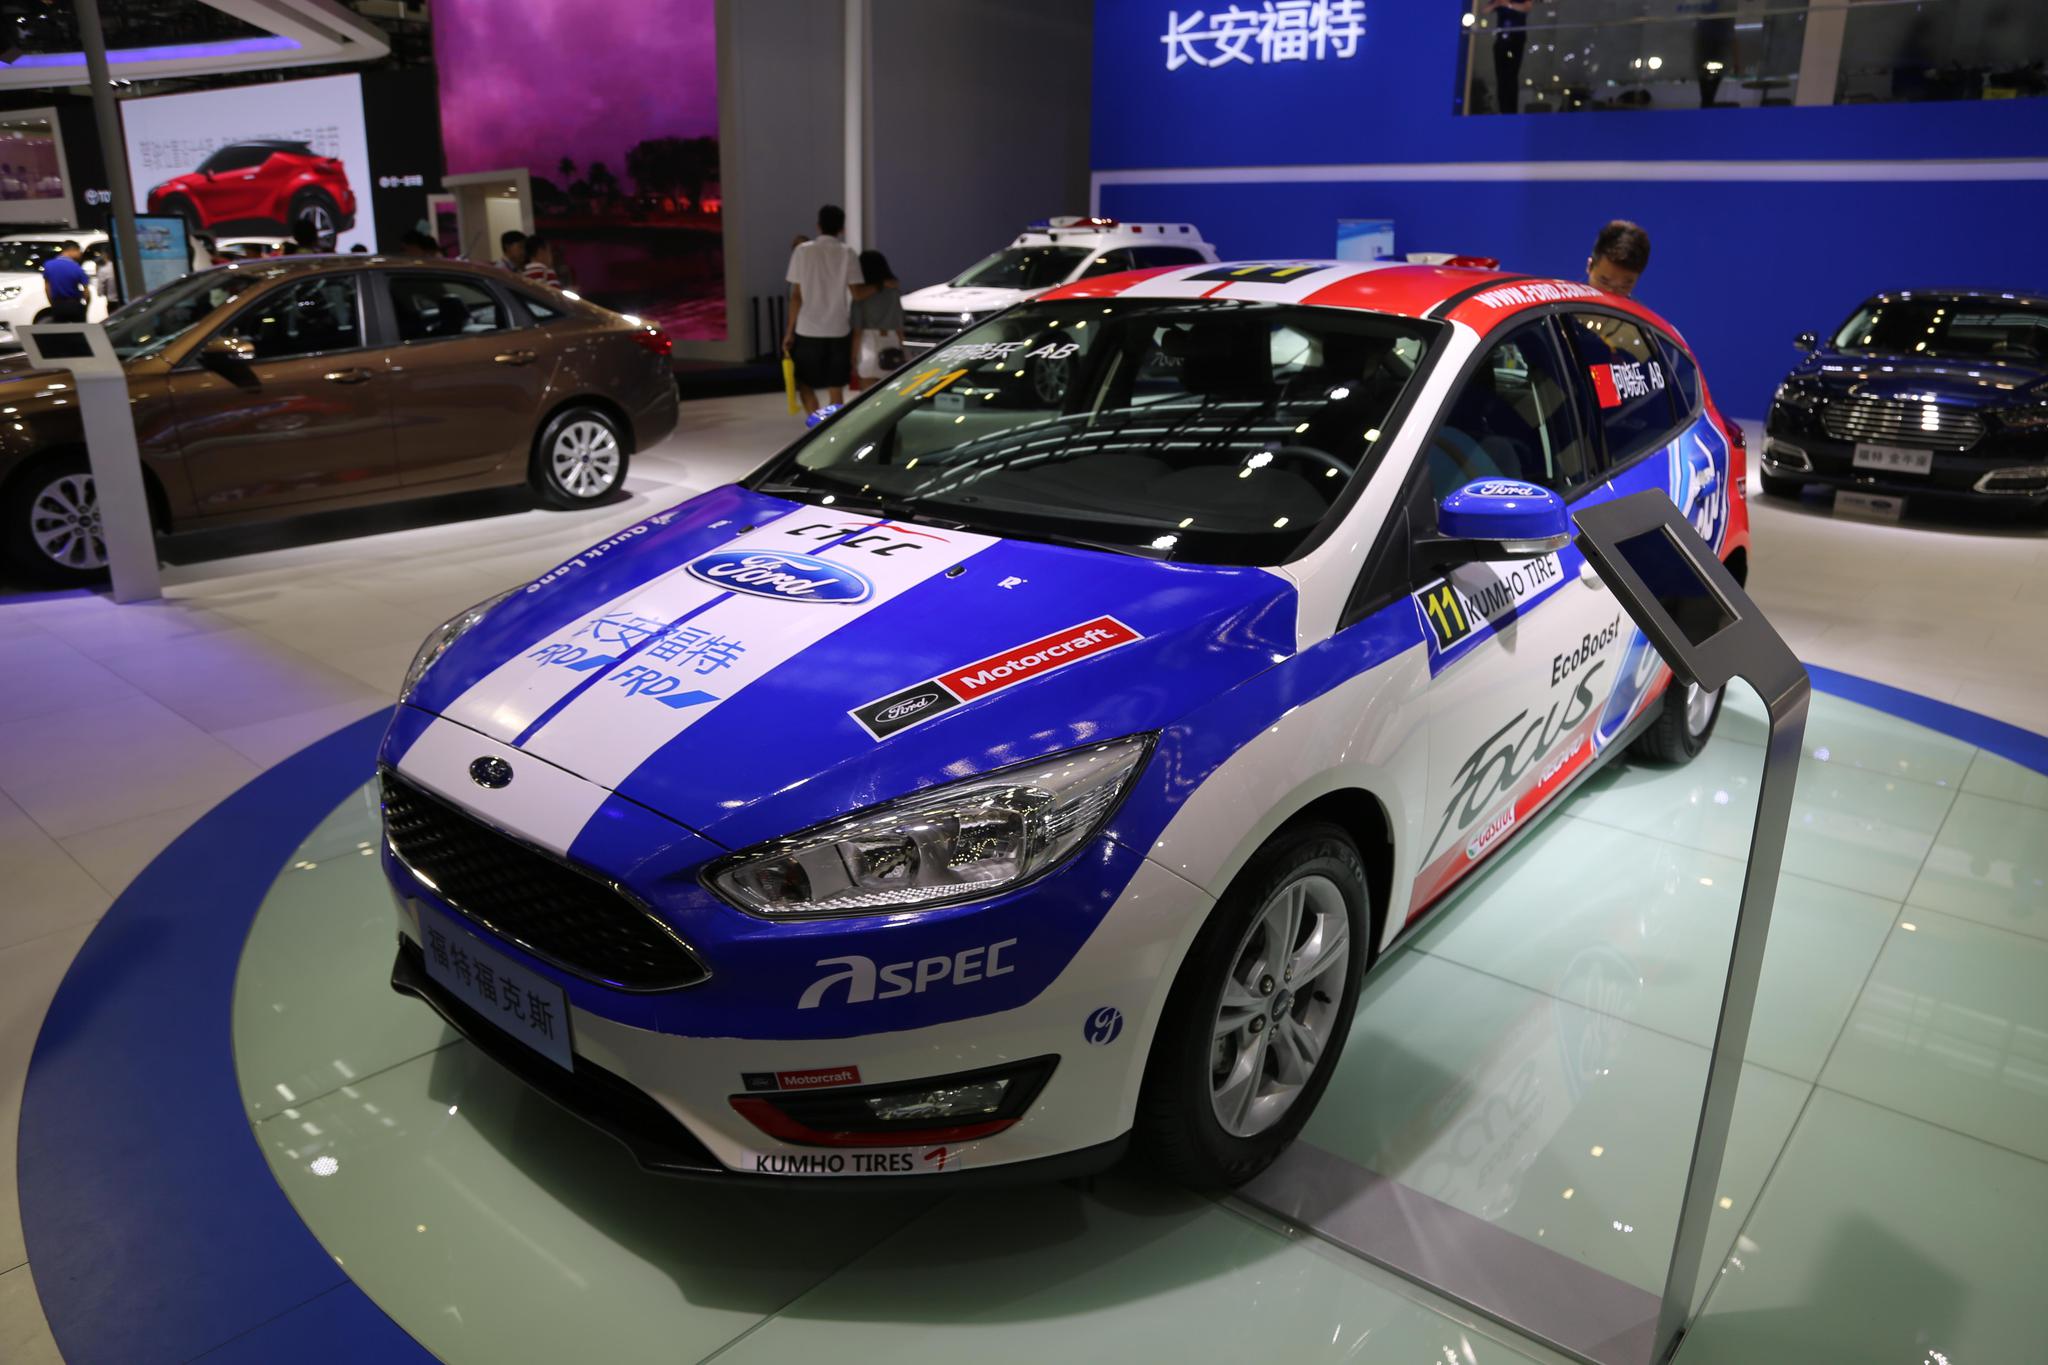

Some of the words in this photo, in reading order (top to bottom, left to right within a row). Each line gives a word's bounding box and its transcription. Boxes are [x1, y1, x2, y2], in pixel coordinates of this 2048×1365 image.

[1160, 0, 1367, 71] 长安福特
[1025, 343, 1079, 359] AB
[898, 367, 968, 397] 11
[1648, 361, 1665, 390] AB
[1481, 482, 1533, 496] Ford
[585, 525, 648, 561] Quick
[785, 524, 923, 556] CTCC
[526, 557, 586, 594] Lane
[707, 555, 840, 597] Ford
[1464, 571, 1525, 625] KUMHO
[1523, 555, 1556, 588] TIRE
[1428, 585, 1466, 640] 11
[527, 643, 588, 668] FRD
[571, 610, 746, 675] 长安福特
[960, 627, 1113, 690] Motorcraft
[1551, 612, 1620, 688] EcoBoost
[608, 665, 681, 698] FRD
[888, 697, 929, 720] Ford
[428, 926, 555, 1041] 福特福克斯
[784, 1071, 853, 1087] Motorcraft
[756, 1154, 845, 1174] KUMHO
[852, 1153, 914, 1172] TIRES
